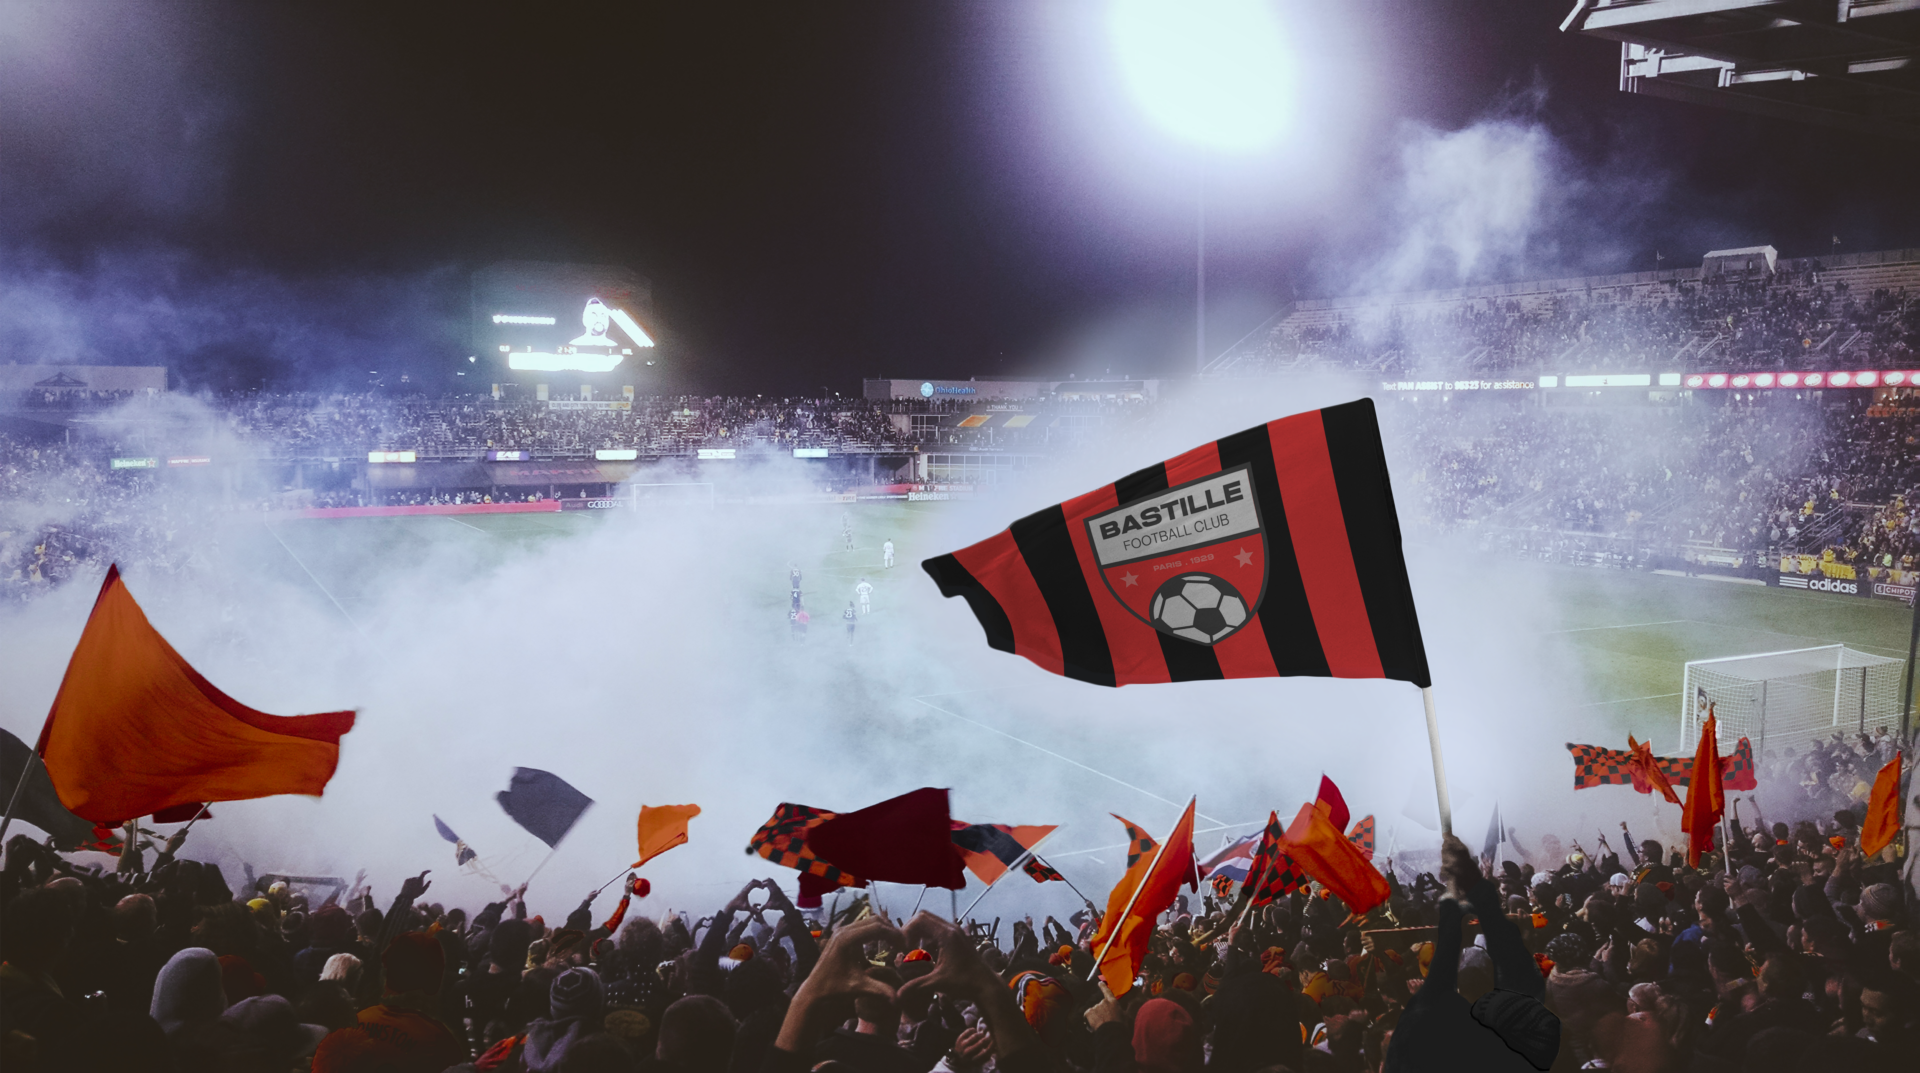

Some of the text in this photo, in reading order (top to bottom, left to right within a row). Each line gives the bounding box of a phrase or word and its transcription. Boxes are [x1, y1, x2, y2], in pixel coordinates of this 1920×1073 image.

[936, 386, 976, 394] OhioHealth
[1382, 381, 1396, 391] Text
[1415, 381, 1443, 391] ASSIST
[1445, 381, 1453, 390] to
[1480, 380, 1491, 390] for
[1493, 379, 1535, 389] assistance
[114, 459, 147, 467] Heineken
[908, 491, 949, 502] Heineken
[1099, 480, 1244, 540] BASTILLE
[1123, 513, 1230, 551] FOOTBALL CLUB
[1153, 560, 1183, 572] PARIS
[1190, 553, 1215, 565] 1929
[1809, 578, 1858, 594] adidas
